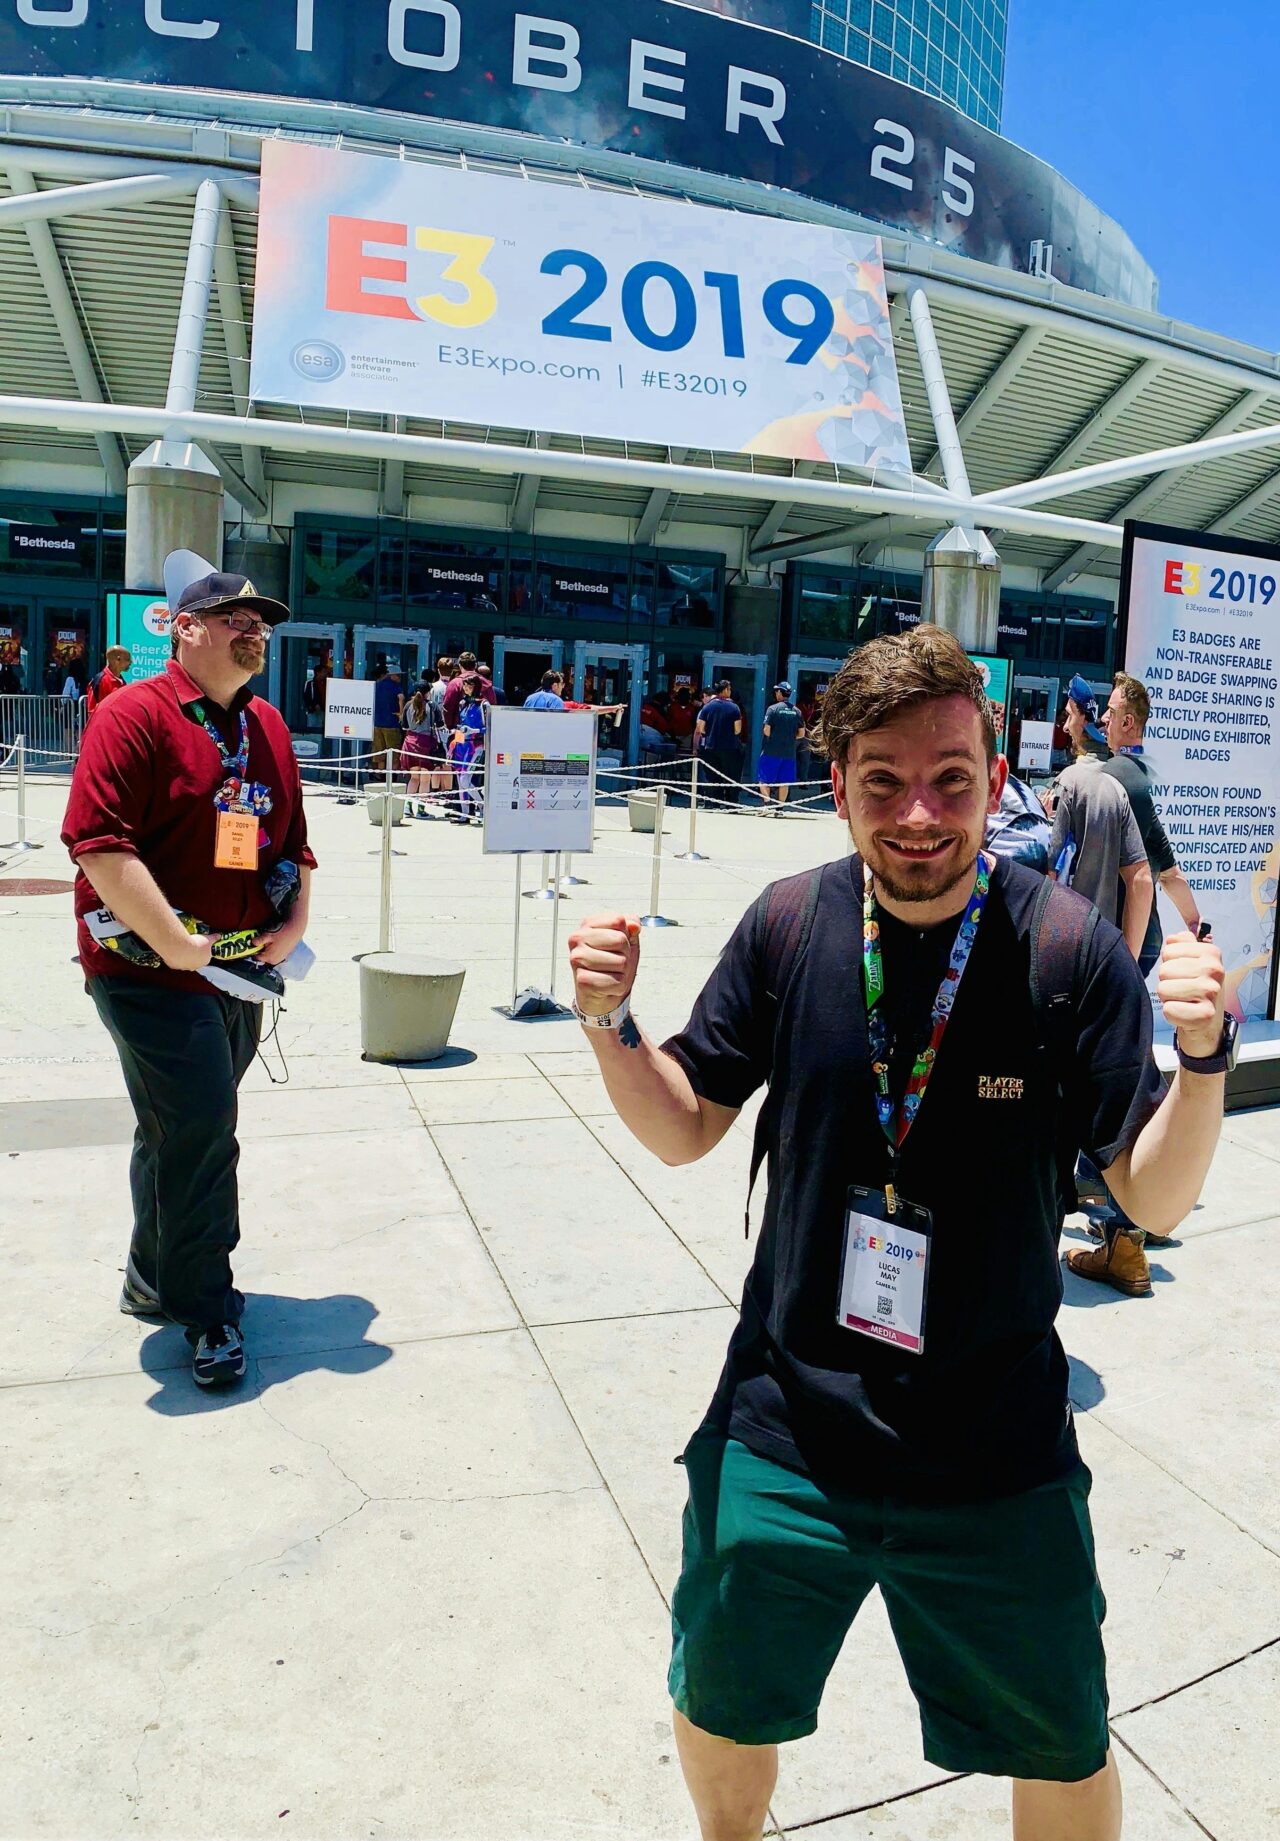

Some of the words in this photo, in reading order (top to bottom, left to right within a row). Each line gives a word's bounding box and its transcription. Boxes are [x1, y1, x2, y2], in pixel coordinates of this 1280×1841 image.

[870, 118, 976, 217] 25
[325, 215, 498, 328] E3
[540, 249, 835, 365] 2019
[302, 354, 334, 367] esa
[351, 355, 416, 368] entertainment
[351, 362, 391, 373] software
[351, 371, 399, 383] association
[438, 345, 601, 382] E3Expo.com
[641, 370, 748, 397] #E32019
[20, 536, 76, 549] Bethesda
[432, 568, 484, 582] Bethesda
[559, 580, 609, 594] Bethesda
[1163, 560, 1201, 597] E3
[1208, 567, 1276, 605] 2019
[1185, 603, 1220, 615] E3Expo.com
[1229, 608, 1253, 618] #E32019
[1172, 629, 1186, 642] E3
[1189, 631, 1235, 648] BADGES
[1239, 637, 1261, 650] ARE
[132, 644, 160, 654] Beer
[1156, 647, 1272, 671] NON-TRANSFERABLE
[1145, 667, 1173, 680] AND
[1177, 670, 1216, 685] BADGE
[1220, 673, 1278, 690] SWAPPING
[1147, 686, 1163, 700] OR
[1168, 688, 1208, 704] BADGE
[1212, 693, 1262, 707] SHARING
[1265, 696, 1275, 708] IS
[329, 705, 372, 716] ENTRANCE
[1148, 707, 1201, 722] STRICTLY
[1203, 711, 1271, 728] PROHIBITED,
[1143, 726, 1210, 742] INCLUDING
[1214, 730, 1271, 745] EXHIBITOR
[1021, 741, 1050, 751] ENTRANCE
[1185, 748, 1230, 762] BADGES
[1148, 785, 1170, 797] ANY
[1173, 785, 1219, 799] PERSON
[1223, 787, 1261, 799] FOUND
[1166, 804, 1220, 817] ANOTHER
[1224, 805, 1276, 818] PERSON'S
[1169, 824, 1195, 835] WILL
[1199, 824, 1227, 836] HAVE
[1231, 824, 1275, 836] HIS/HER
[1169, 842, 1247, 854] CONFISCATED
[1250, 843, 1273, 854] AND
[1216, 861, 1232, 872] TO
[1234, 861, 1266, 872] LEAVE
[978, 1076, 1023, 1088] PLAYER
[978, 1087, 1024, 1099] SELECT
[886, 1242, 913, 1261] 2019
[878, 1262, 901, 1274] LUCAS
[880, 1272, 897, 1282] MAY
[870, 1325, 897, 1341] MEDIA
